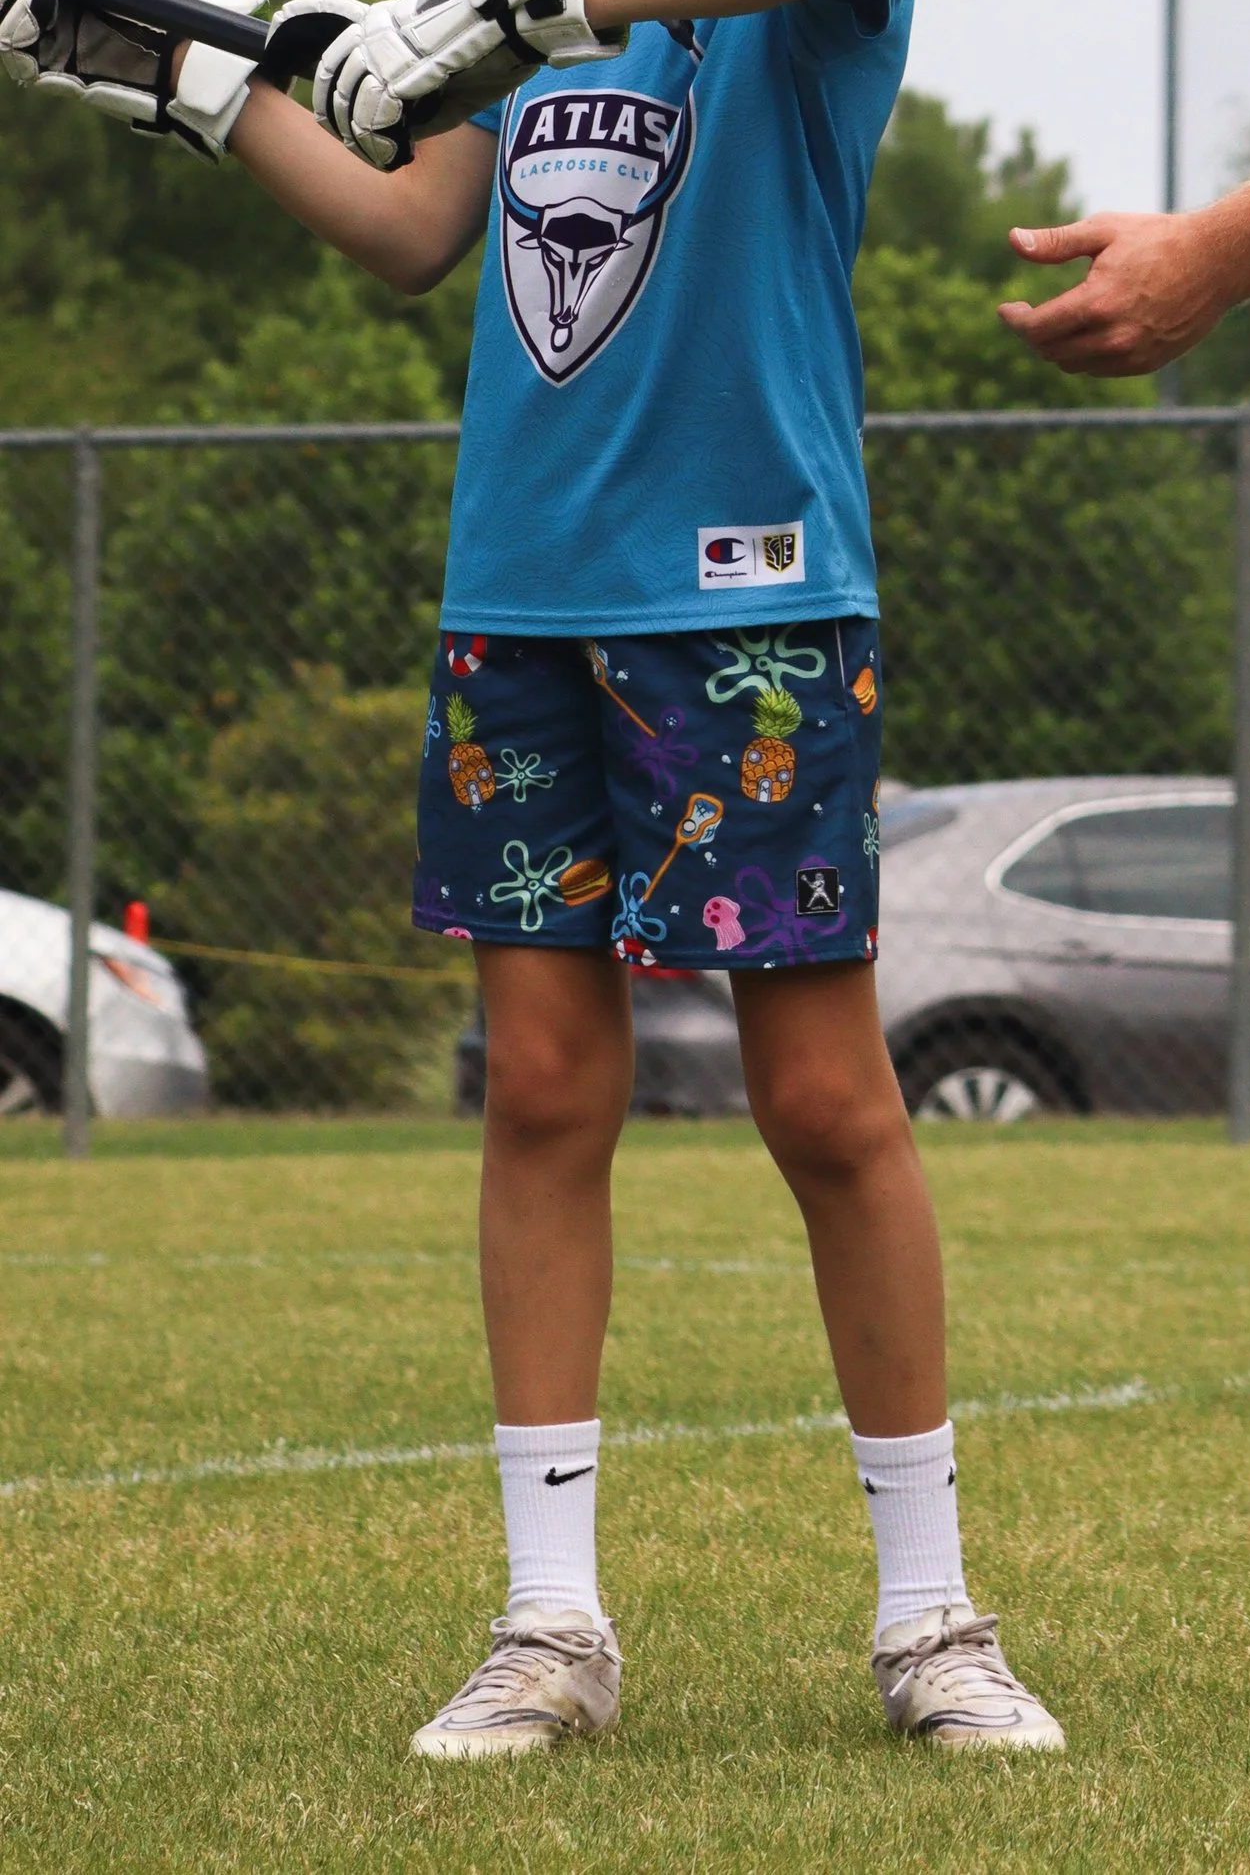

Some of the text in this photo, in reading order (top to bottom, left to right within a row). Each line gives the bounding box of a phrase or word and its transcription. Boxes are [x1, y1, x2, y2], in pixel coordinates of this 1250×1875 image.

[528, 102, 668, 153] ATLAS
[520, 159, 608, 179] LACROSSE
[782, 536, 793, 563] PLL
[704, 571, 747, 579] Champion
